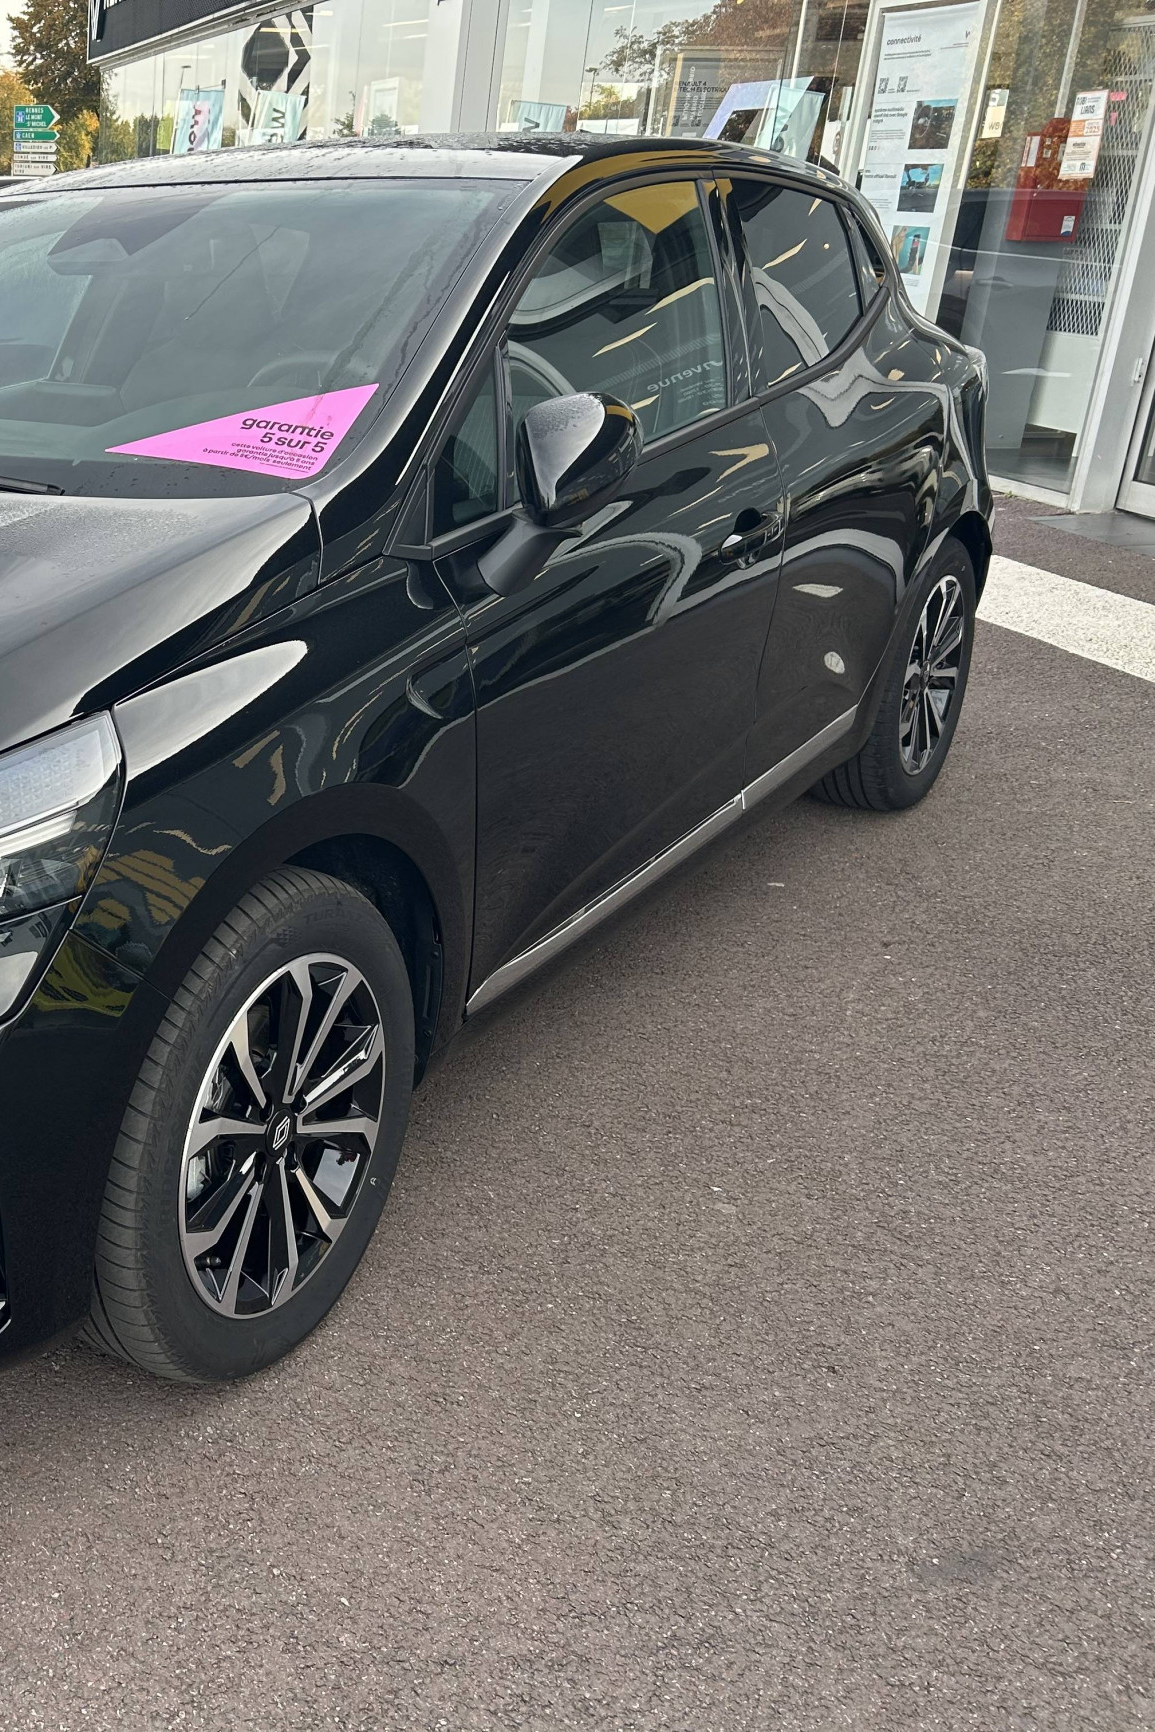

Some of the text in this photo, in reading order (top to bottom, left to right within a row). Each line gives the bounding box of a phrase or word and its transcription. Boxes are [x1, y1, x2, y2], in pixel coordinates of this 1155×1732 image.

[239, 417, 335, 441] garantie
[236, 447, 268, 458] garantie
[251, 444, 278, 454] voiture
[277, 448, 319, 461] d'occasion
[259, 431, 328, 454] 5 sur 5
[207, 448, 230, 456] partir
[272, 458, 313, 471] seulement
